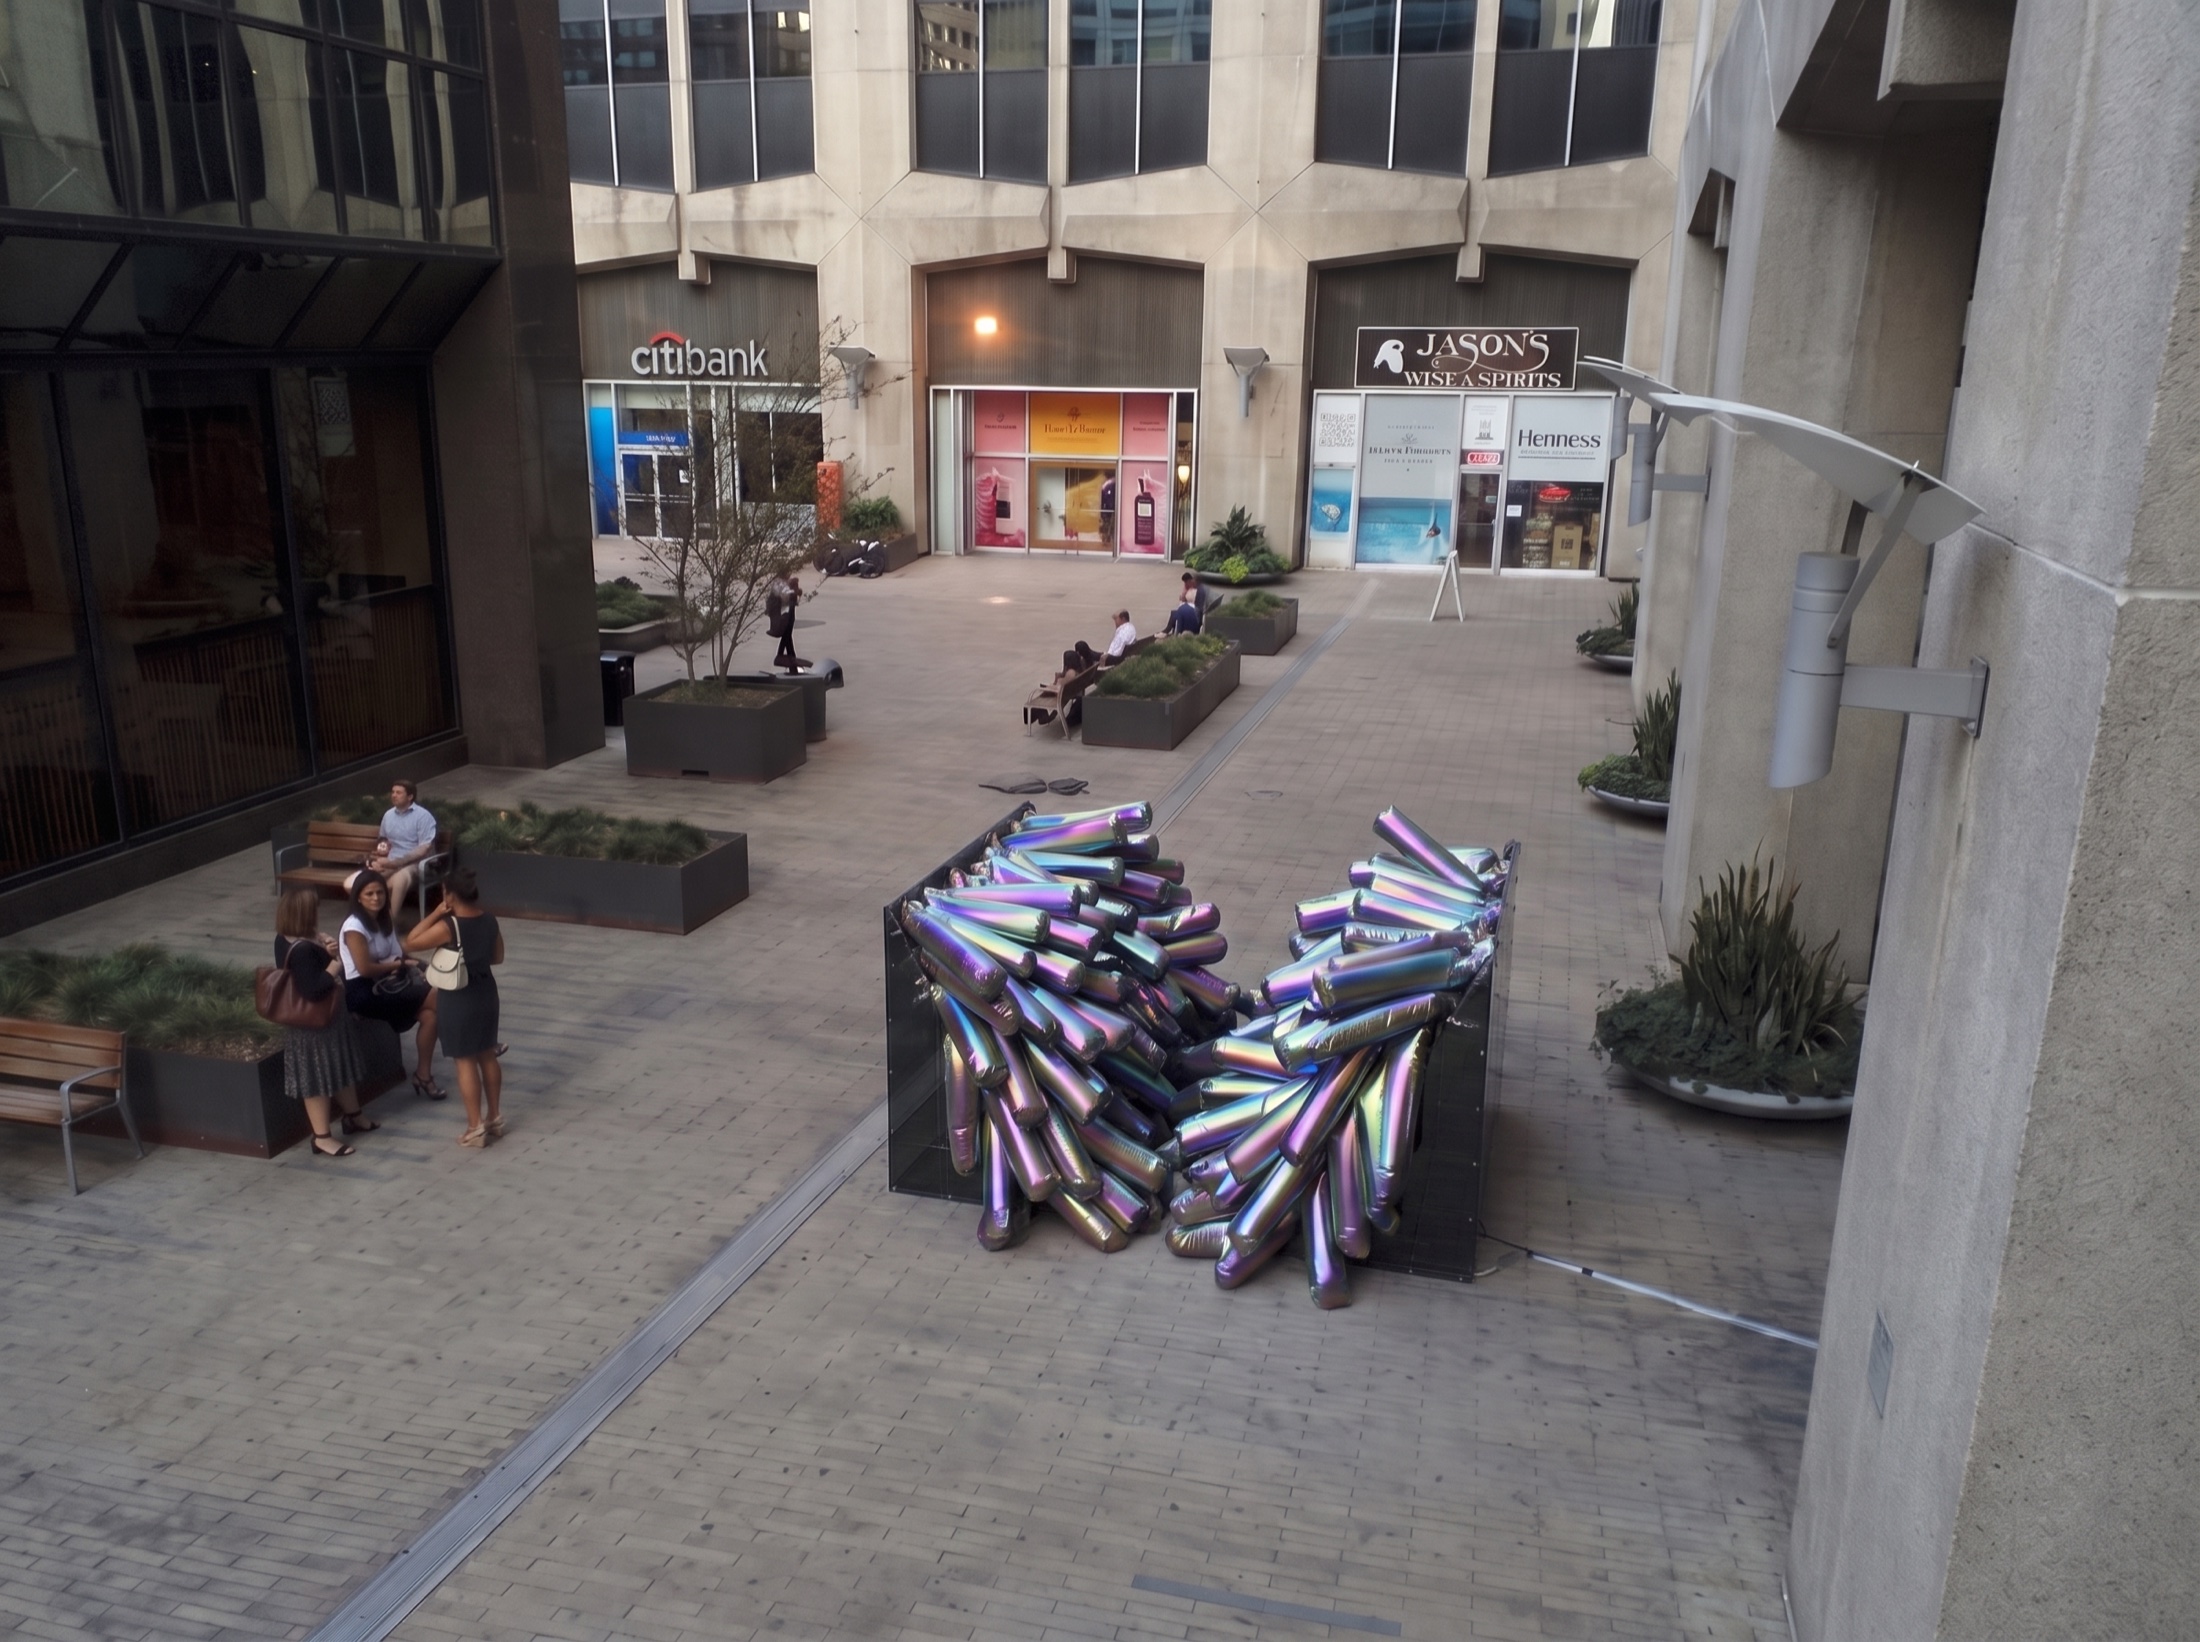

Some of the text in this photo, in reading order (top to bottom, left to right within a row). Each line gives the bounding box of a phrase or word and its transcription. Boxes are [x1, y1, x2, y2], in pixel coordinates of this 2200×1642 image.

[631, 338, 768, 376] citibank
[1417, 331, 1549, 369] JASON'S
[1478, 372, 1561, 388] SPIRITS
[1518, 429, 1601, 448] Henness
